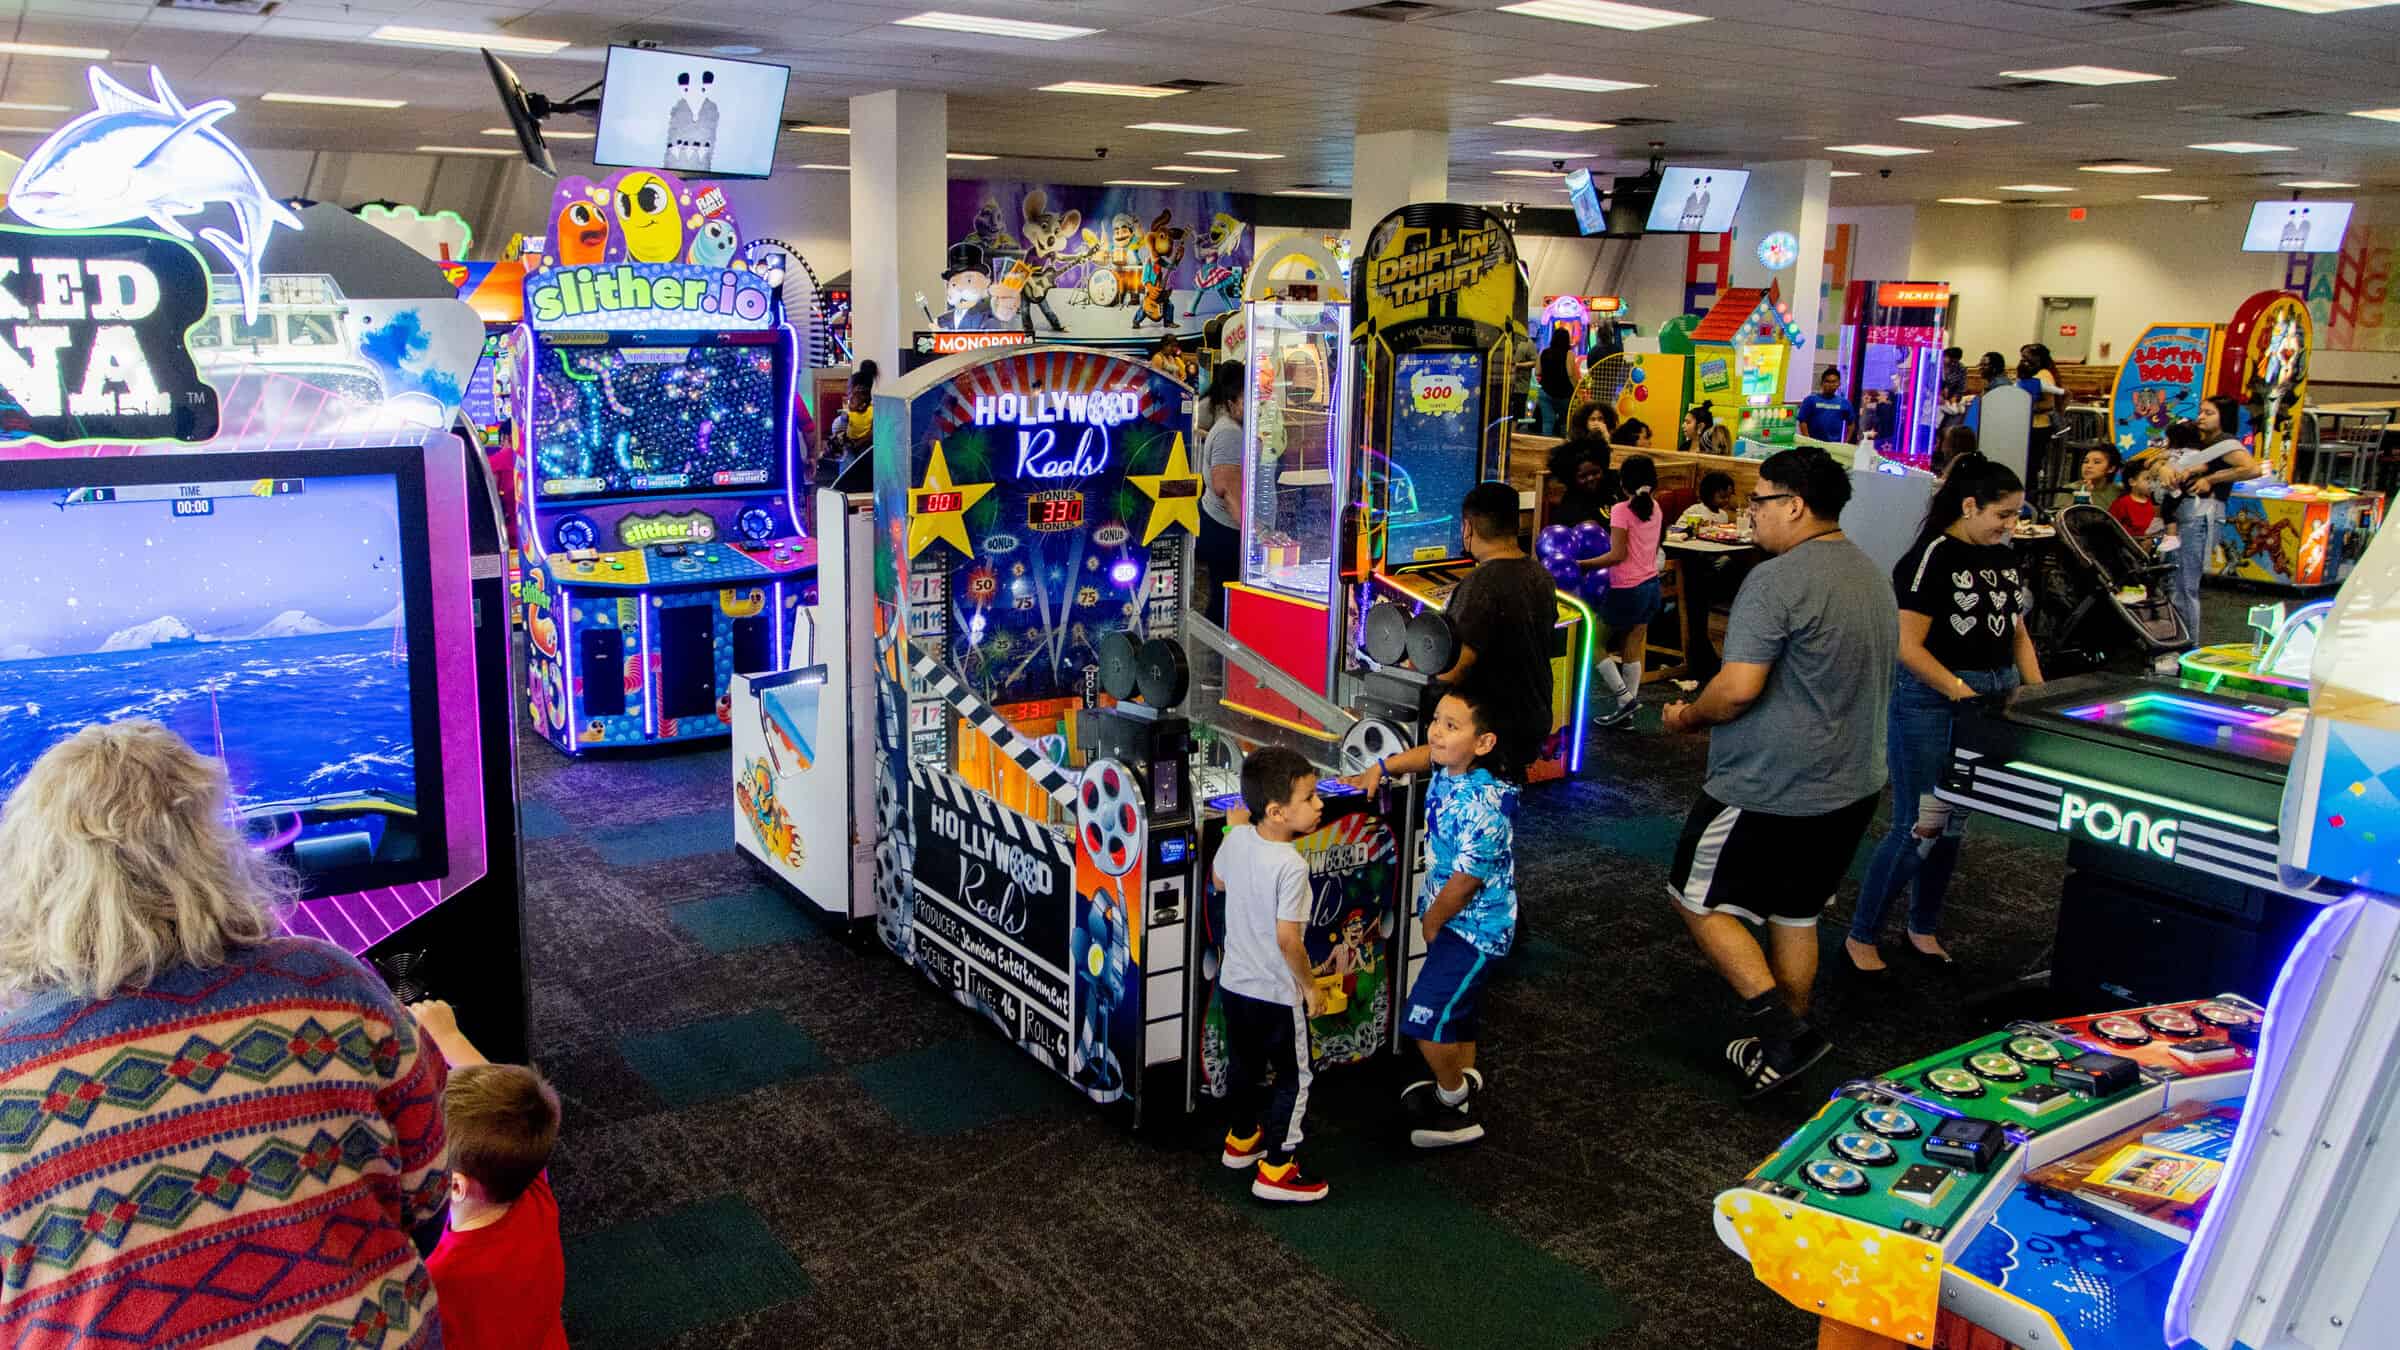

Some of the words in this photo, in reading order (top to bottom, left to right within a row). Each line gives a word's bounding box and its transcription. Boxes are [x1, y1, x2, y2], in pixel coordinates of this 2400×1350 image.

[1378, 244, 1457, 286] DRIFT
[533, 265, 768, 322] slither.io
[1391, 261, 1483, 309] THRIFT
[938, 333, 1025, 348] MONOPOLY
[186, 392, 205, 404] TM
[1422, 386, 1452, 400] 300
[974, 391, 1139, 426] HOLLYWOOD
[1016, 427, 1110, 479] Reels
[179, 485, 202, 497] TIME
[1036, 491, 1075, 500] BONUS
[177, 500, 209, 514] 00:00
[624, 520, 712, 543] slither.io
[1036, 521, 1075, 531] BONUS
[987, 537, 1015, 551] BONUS
[975, 579, 993, 591] 50
[1080, 591, 1097, 603] 75
[1015, 597, 1033, 609] 75
[2060, 792, 2179, 859] PONG
[930, 803, 1053, 896] HOLLYWOOD
[958, 855, 1027, 934] Reels
[914, 892, 960, 943] PRODUCER:
[961, 927, 997, 964] Jennison
[998, 947, 1070, 1017] Entertainment
[920, 937, 951, 978] SCENE:
[953, 960, 963, 988] 5
[970, 972, 997, 1010] TAKE:
[1001, 993, 1017, 1022] 16
[1026, 1009, 1055, 1052] ROLL:
[1056, 1032, 1067, 1057] 6
